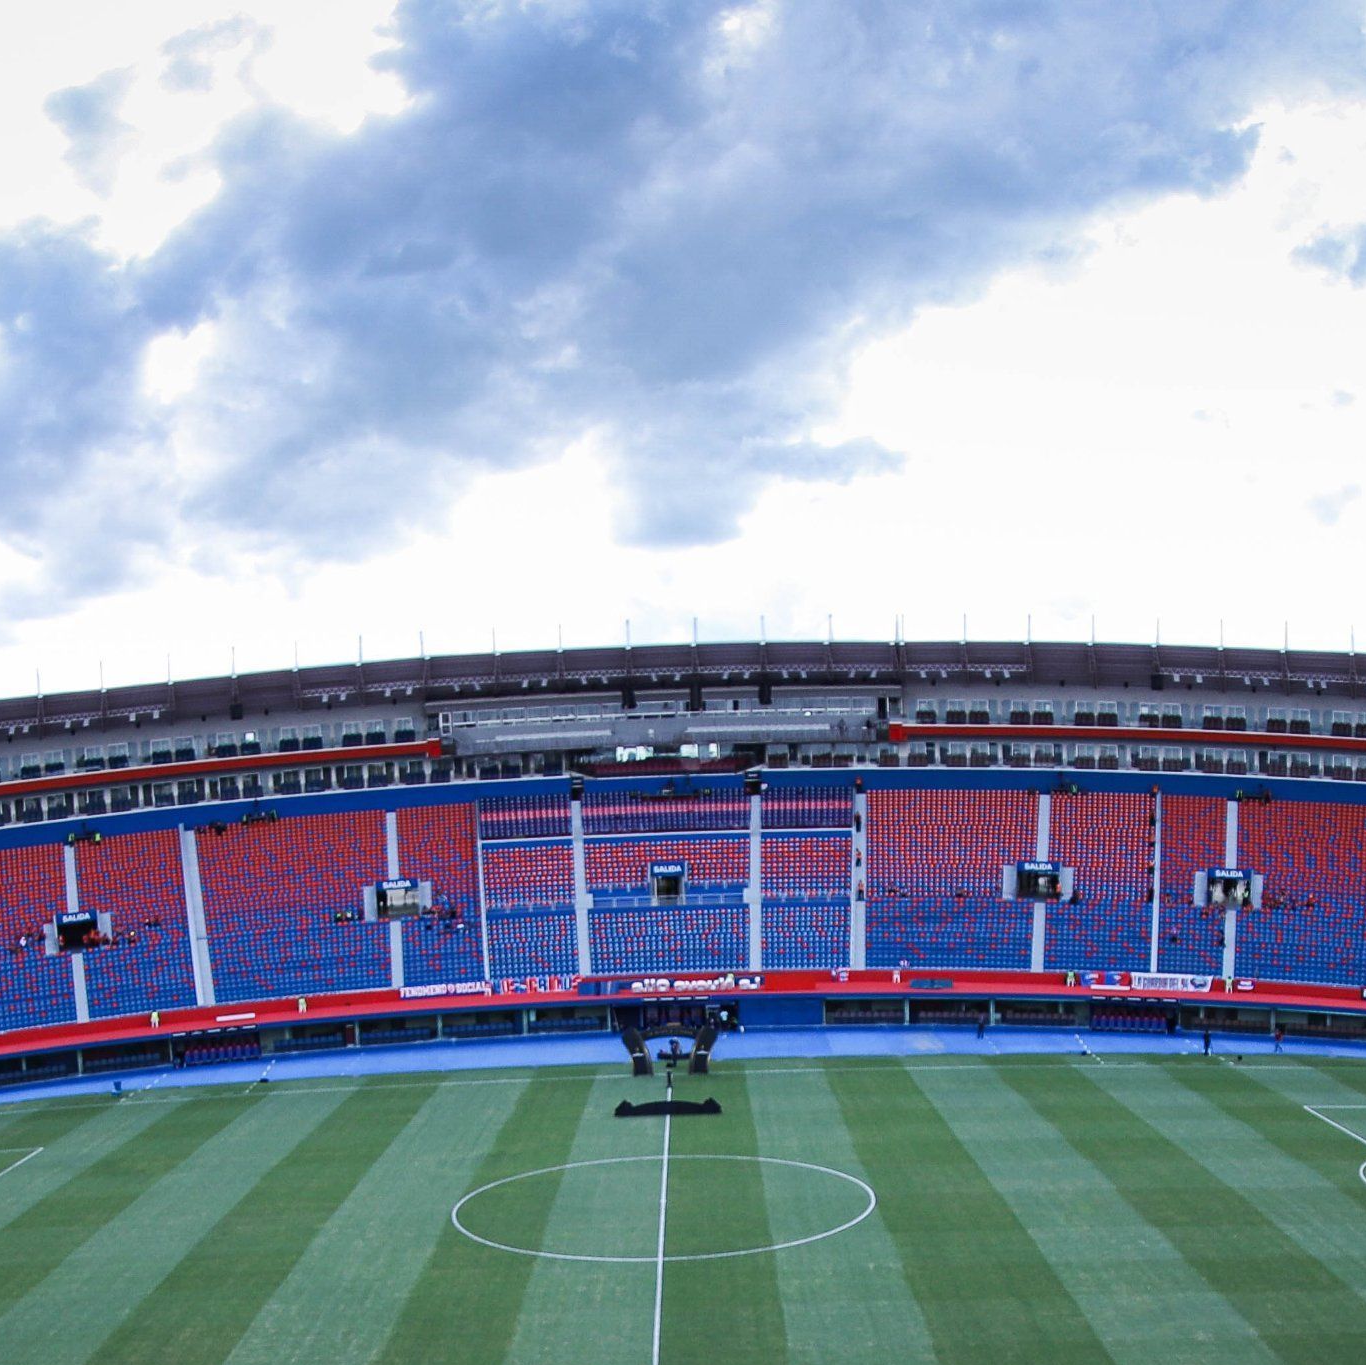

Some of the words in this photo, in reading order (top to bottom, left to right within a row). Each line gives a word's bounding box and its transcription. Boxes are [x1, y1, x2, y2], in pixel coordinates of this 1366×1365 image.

[653, 865, 682, 873] SALIDA
[1024, 863, 1053, 871] SALIDA
[1215, 869, 1244, 878] SALIDA
[383, 880, 411, 888] SALIDA
[62, 912, 91, 923] SALIDA
